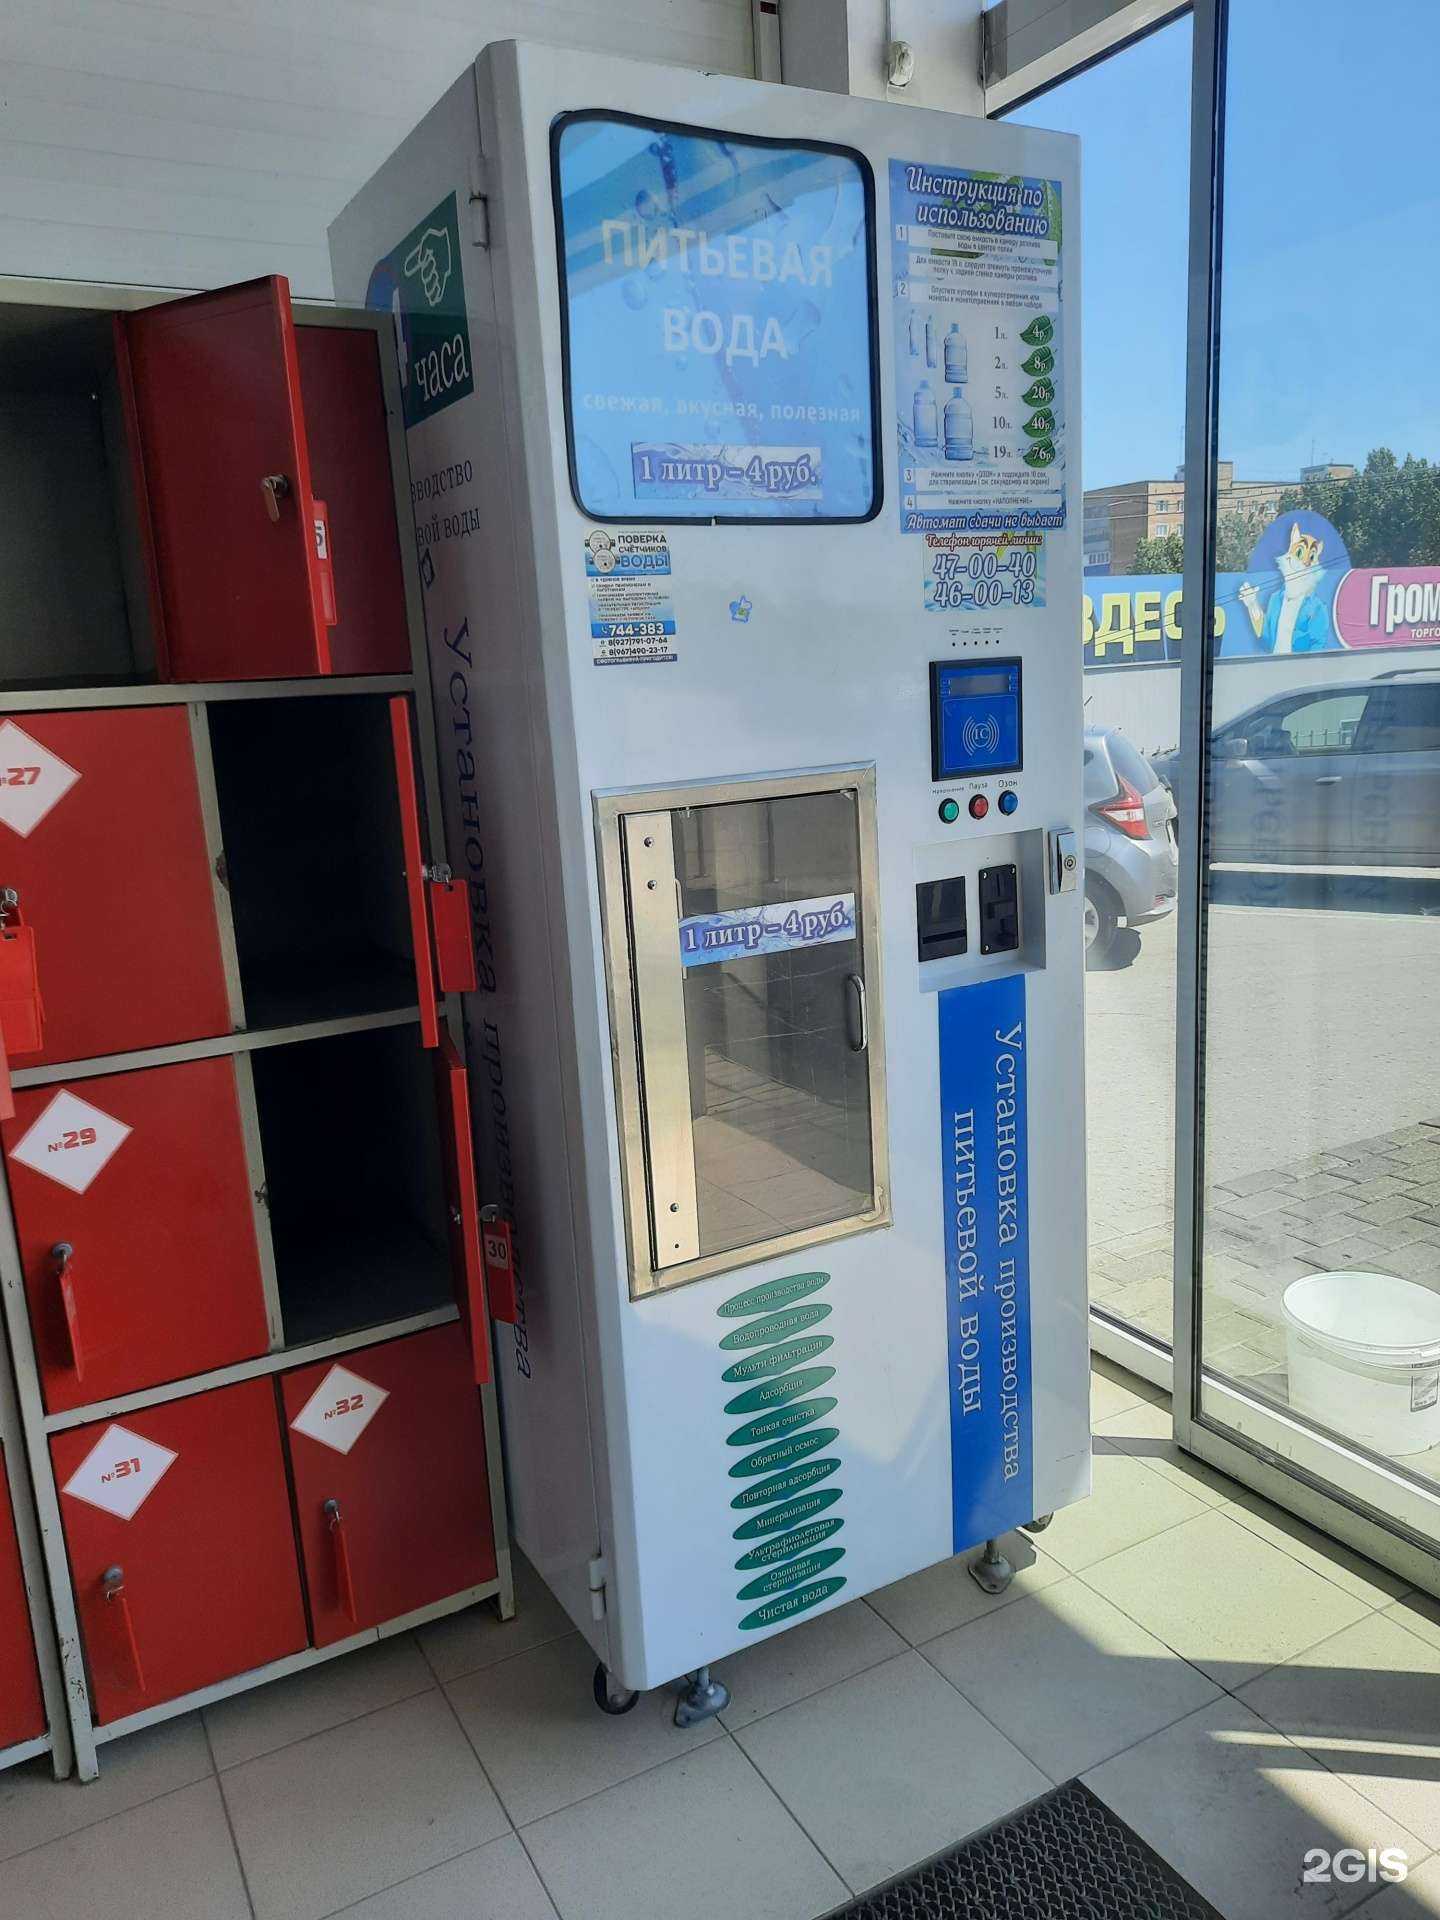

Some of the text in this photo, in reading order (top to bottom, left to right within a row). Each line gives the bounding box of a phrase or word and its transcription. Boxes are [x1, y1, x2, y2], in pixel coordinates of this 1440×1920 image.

[906, 166, 1042, 206] Инструкция по
[917, 204, 1048, 234] использованию
[602, 219, 833, 287] ПИТЬЕВАЯ
[900, 282, 906, 295] 2
[663, 308, 789, 366] ВОДА
[413, 333, 469, 401] часа
[584, 393, 861, 422] свежая, вкусная, полезная
[641, 456, 653, 481] 1
[661, 461, 721, 489] литр
[748, 457, 763, 481] 4
[768, 456, 816, 489] руб.
[907, 511, 1064, 531] Автомат сдачи не выдает
[618, 535, 667, 544] ПОВЕРКА
[618, 544, 667, 553] СЧЁТЧИКОВ
[926, 533, 971, 550] Телефон
[972, 534, 1009, 551] горячей
[620, 554, 668, 569] ВОДЫ
[933, 552, 1036, 580] 47-00-40
[934, 579, 1034, 608] 46-00-13
[608, 638, 668, 647] 8(927)791-07-64
[609, 622, 664, 636] 744-383
[609, 647, 668, 656] 8(967)490-23-17
[975, 728, 990, 740] IC
[969, 781, 988, 791] Пауза
[998, 779, 1018, 788] Озон
[443, 616, 498, 993] Установка
[687, 929, 696, 949] 1
[705, 920, 761, 947] литр
[785, 911, 798, 934] 4
[802, 902, 848, 938] руб.
[995, 1021, 1023, 1248] Установка
[954, 1109, 984, 1303] питьевой
[488, 1240, 507, 1260] 30
[755, 1282, 805, 1304] производства
[733, 1309, 820, 1345] Водопроводная вода
[733, 1340, 823, 1378] Мульти фильтрация
[959, 1311, 983, 1417] воды
[995, 1257, 1020, 1482] производства
[759, 1379, 803, 1401] Адсорбция
[751, 1408, 816, 1437] Тонкая очистка
[750, 1437, 819, 1468] Обратный осмос
[742, 1463, 831, 1504] Повторная адсорбция
[756, 1498, 821, 1530] Минерализация
[749, 1519, 835, 1559] Ультрафиолетовая
[761, 1532, 826, 1562] стерилизация
[763, 1562, 821, 1592] стерилизация
[770, 1560, 812, 1582] Озоновая
[758, 1584, 828, 1621] Чистая вода
